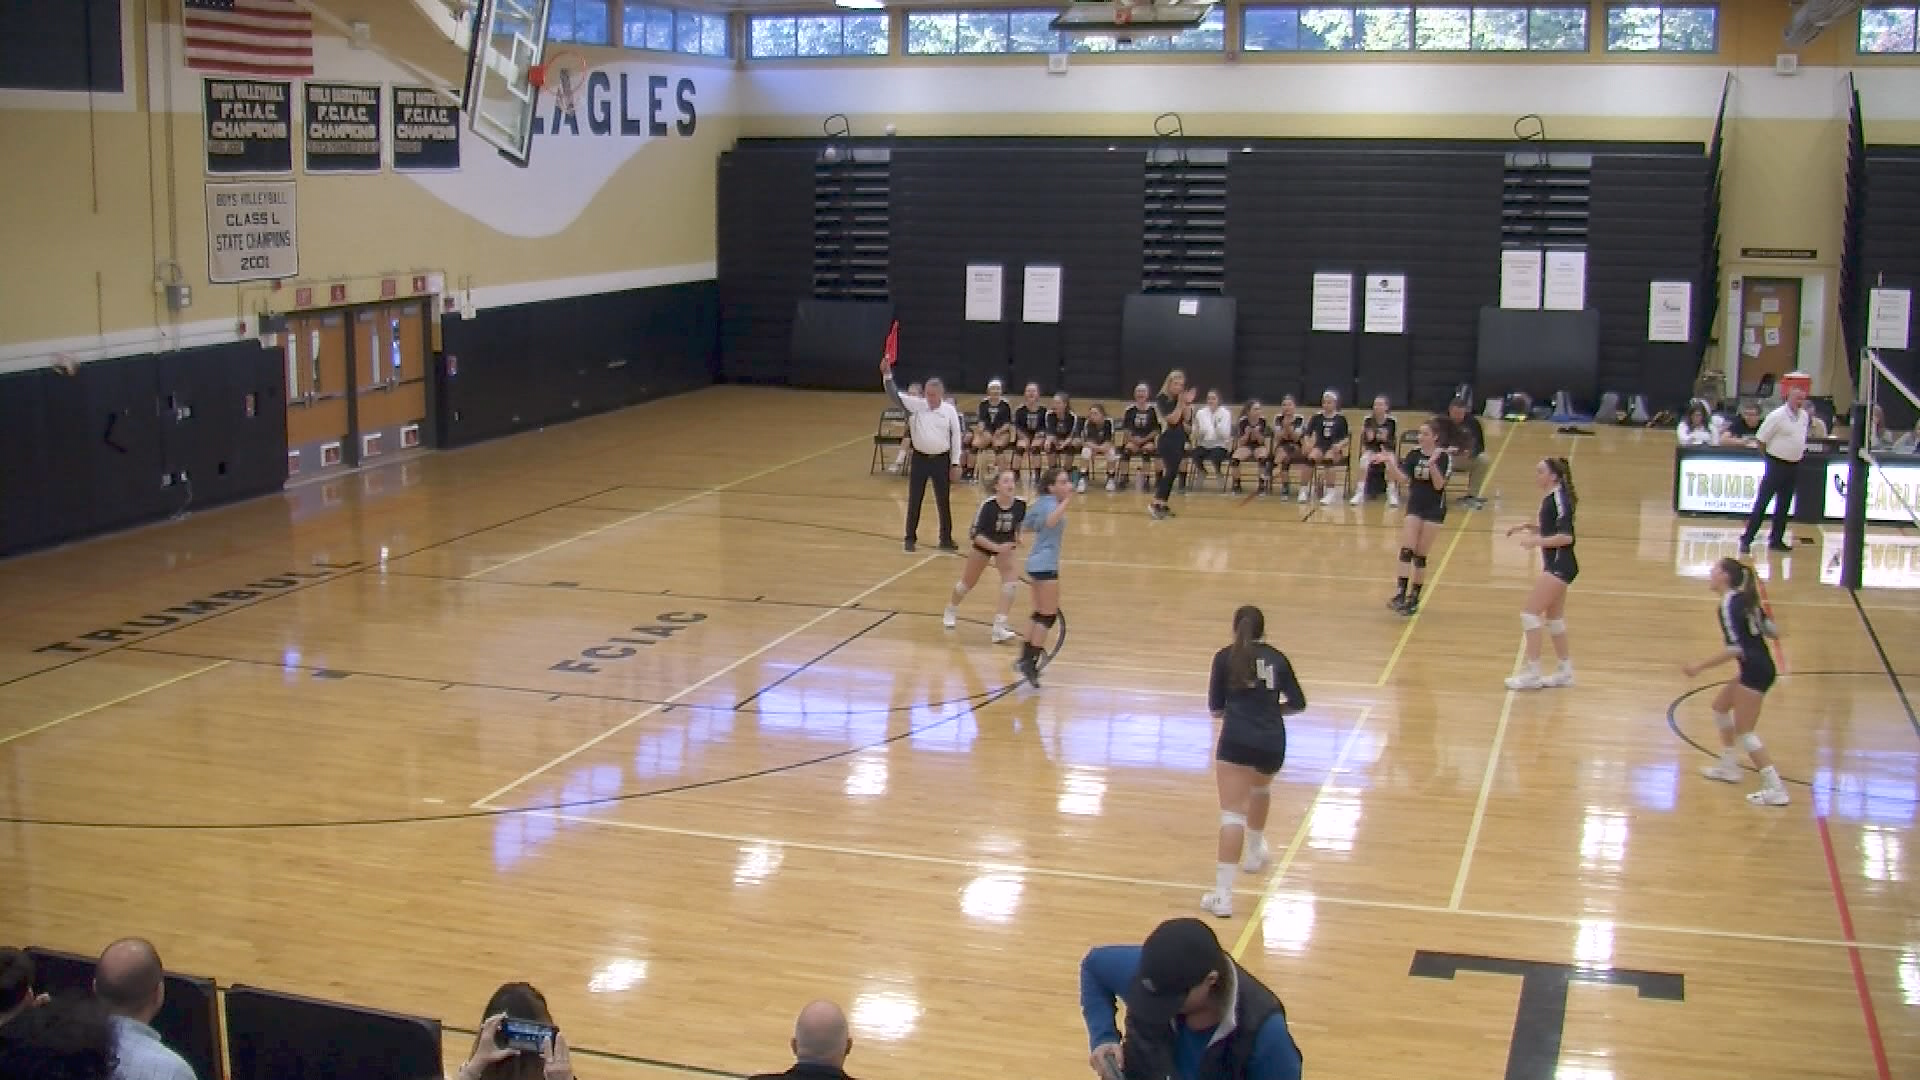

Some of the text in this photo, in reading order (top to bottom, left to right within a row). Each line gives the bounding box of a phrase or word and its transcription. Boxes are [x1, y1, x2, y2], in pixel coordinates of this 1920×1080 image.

[216, 191, 287, 206] BOYS VOLLEYBALL
[226, 211, 280, 226] CLASS L
[216, 230, 291, 252] STATE CHAMPIONS
[240, 256, 270, 270] 2001
[32, 560, 362, 654] TRUMBULL
[548, 611, 709, 674] FCIAC
[1408, 949, 1685, 1080] T
